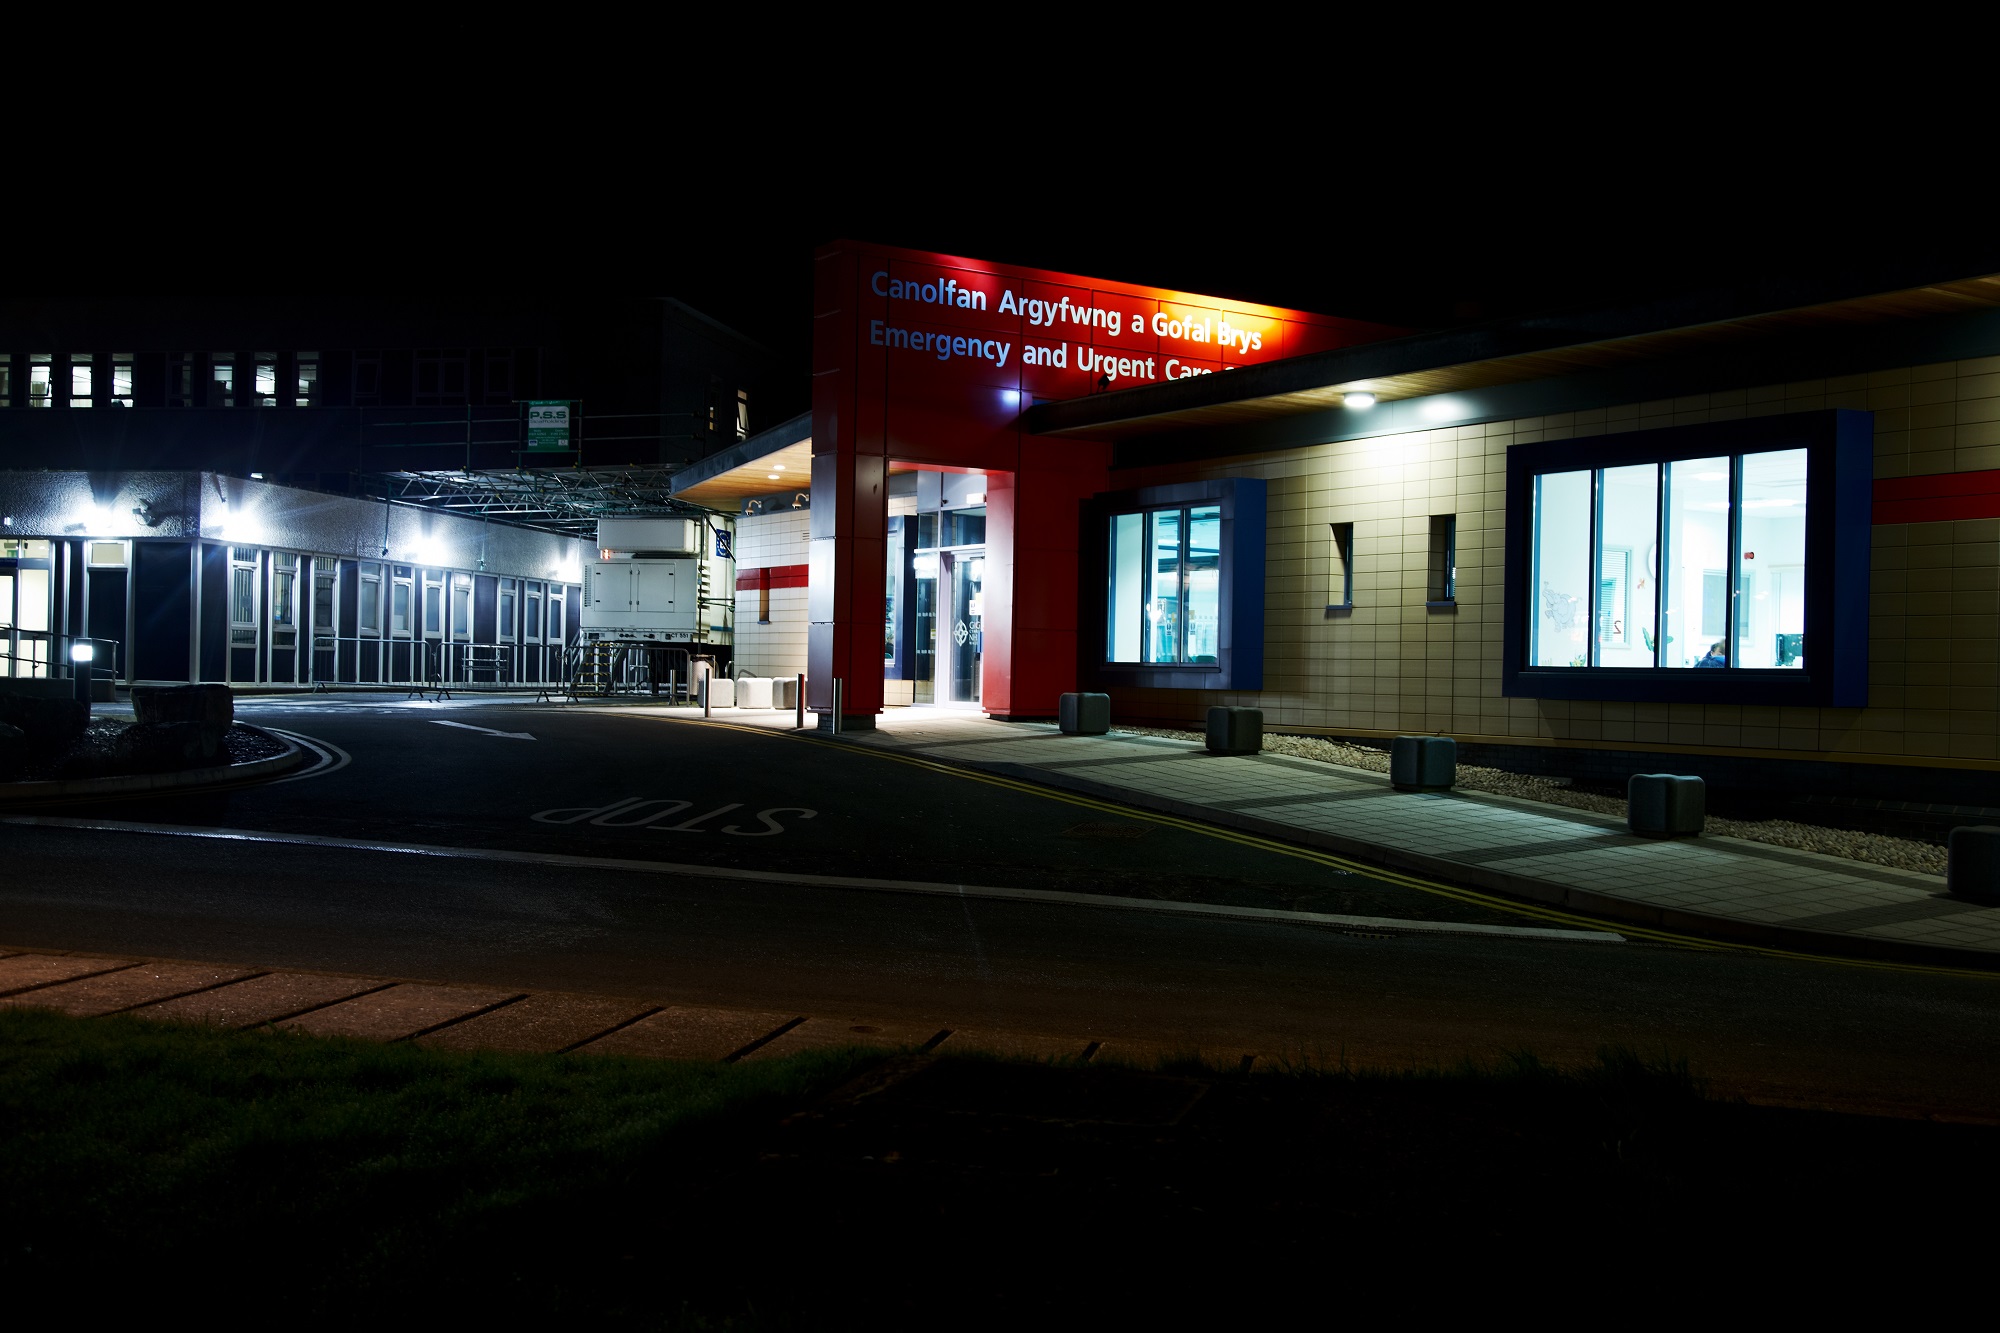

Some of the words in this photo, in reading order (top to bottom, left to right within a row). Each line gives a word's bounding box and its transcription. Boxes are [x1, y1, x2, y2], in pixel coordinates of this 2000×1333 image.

[871, 271, 987, 311] Canolfan
[998, 289, 1122, 337] Argyfwng
[1131, 314, 1145, 334] a
[1151, 312, 1211, 344] Gofal
[1217, 320, 1262, 354] Brys
[870, 319, 1011, 368] Emergency
[1022, 342, 1067, 369] and
[1077, 346, 1155, 382] Urgent
[529, 797, 819, 837] STOP
